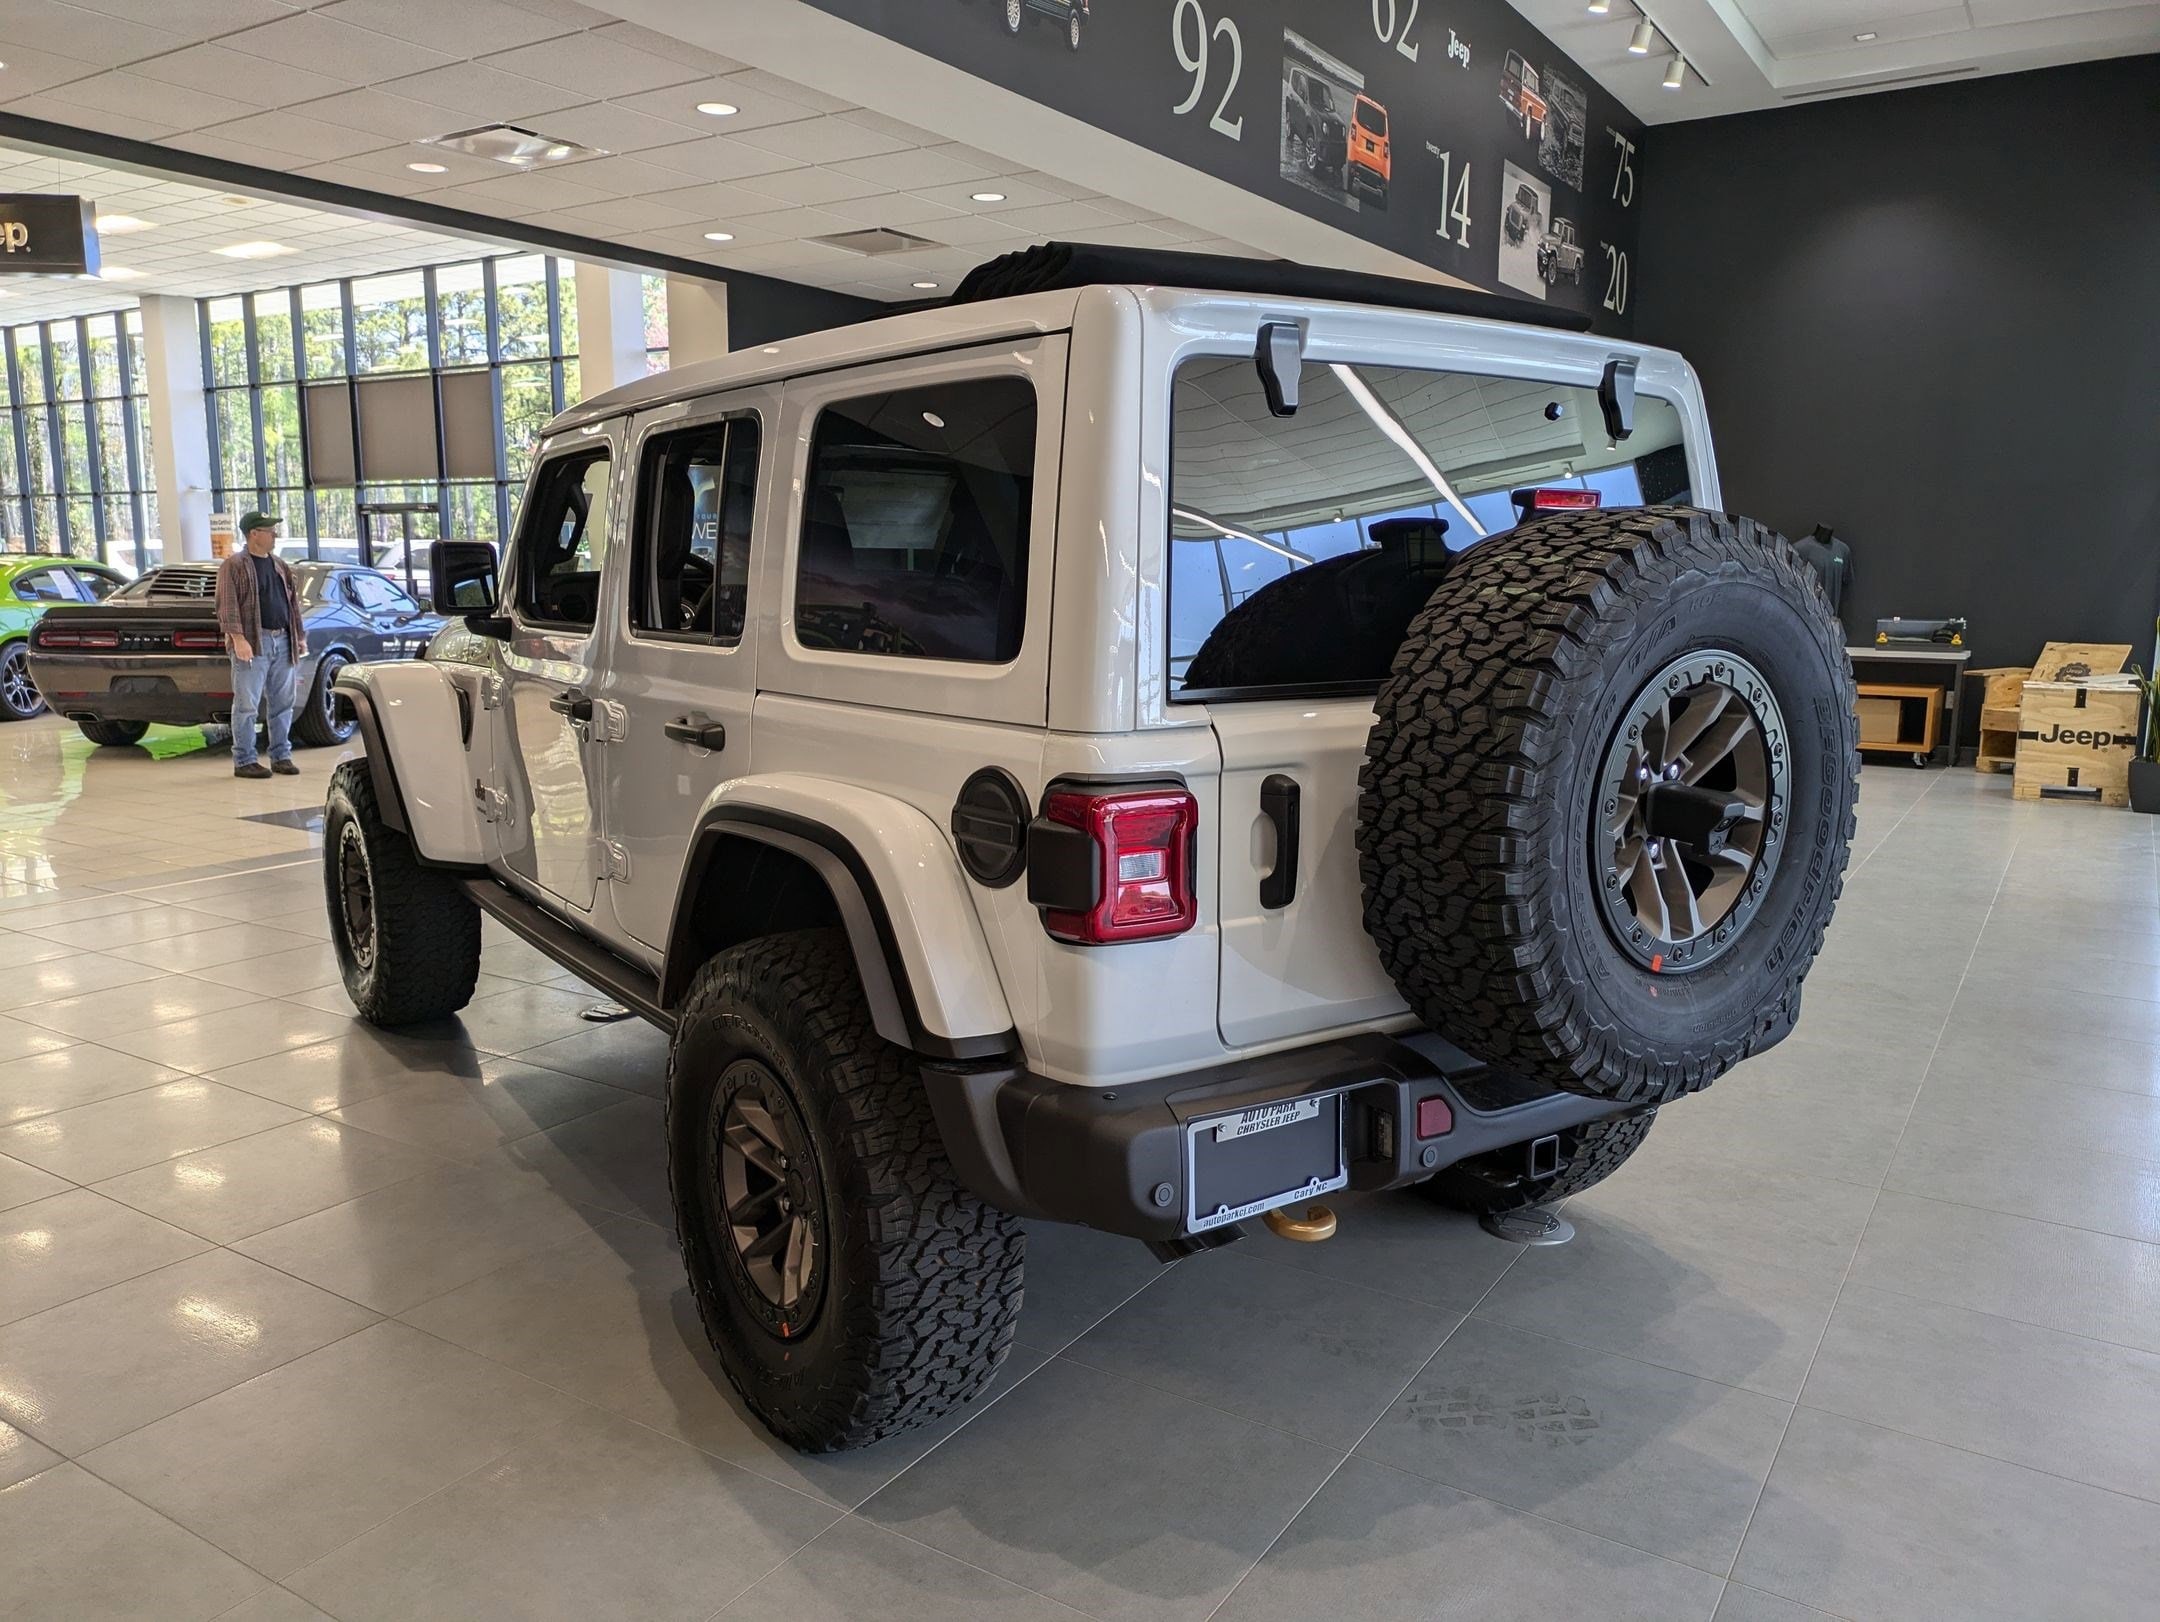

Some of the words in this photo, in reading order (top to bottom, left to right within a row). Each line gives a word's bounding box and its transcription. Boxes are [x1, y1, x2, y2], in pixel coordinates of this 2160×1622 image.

[1172, 0, 1243, 142] 92
[1447, 27, 1470, 68] Jeep
[1613, 131, 1636, 208] 75
[1436, 151, 1472, 249] 14
[1603, 245, 1628, 316] 20
[2040, 723, 2111, 750] Jeep
[1236, 1116, 1281, 1136] CHRYSLER
[1281, 1111, 1301, 1124] JEEP
[1293, 1187, 1315, 1200] Cary
[1315, 1182, 1328, 1192] NC
